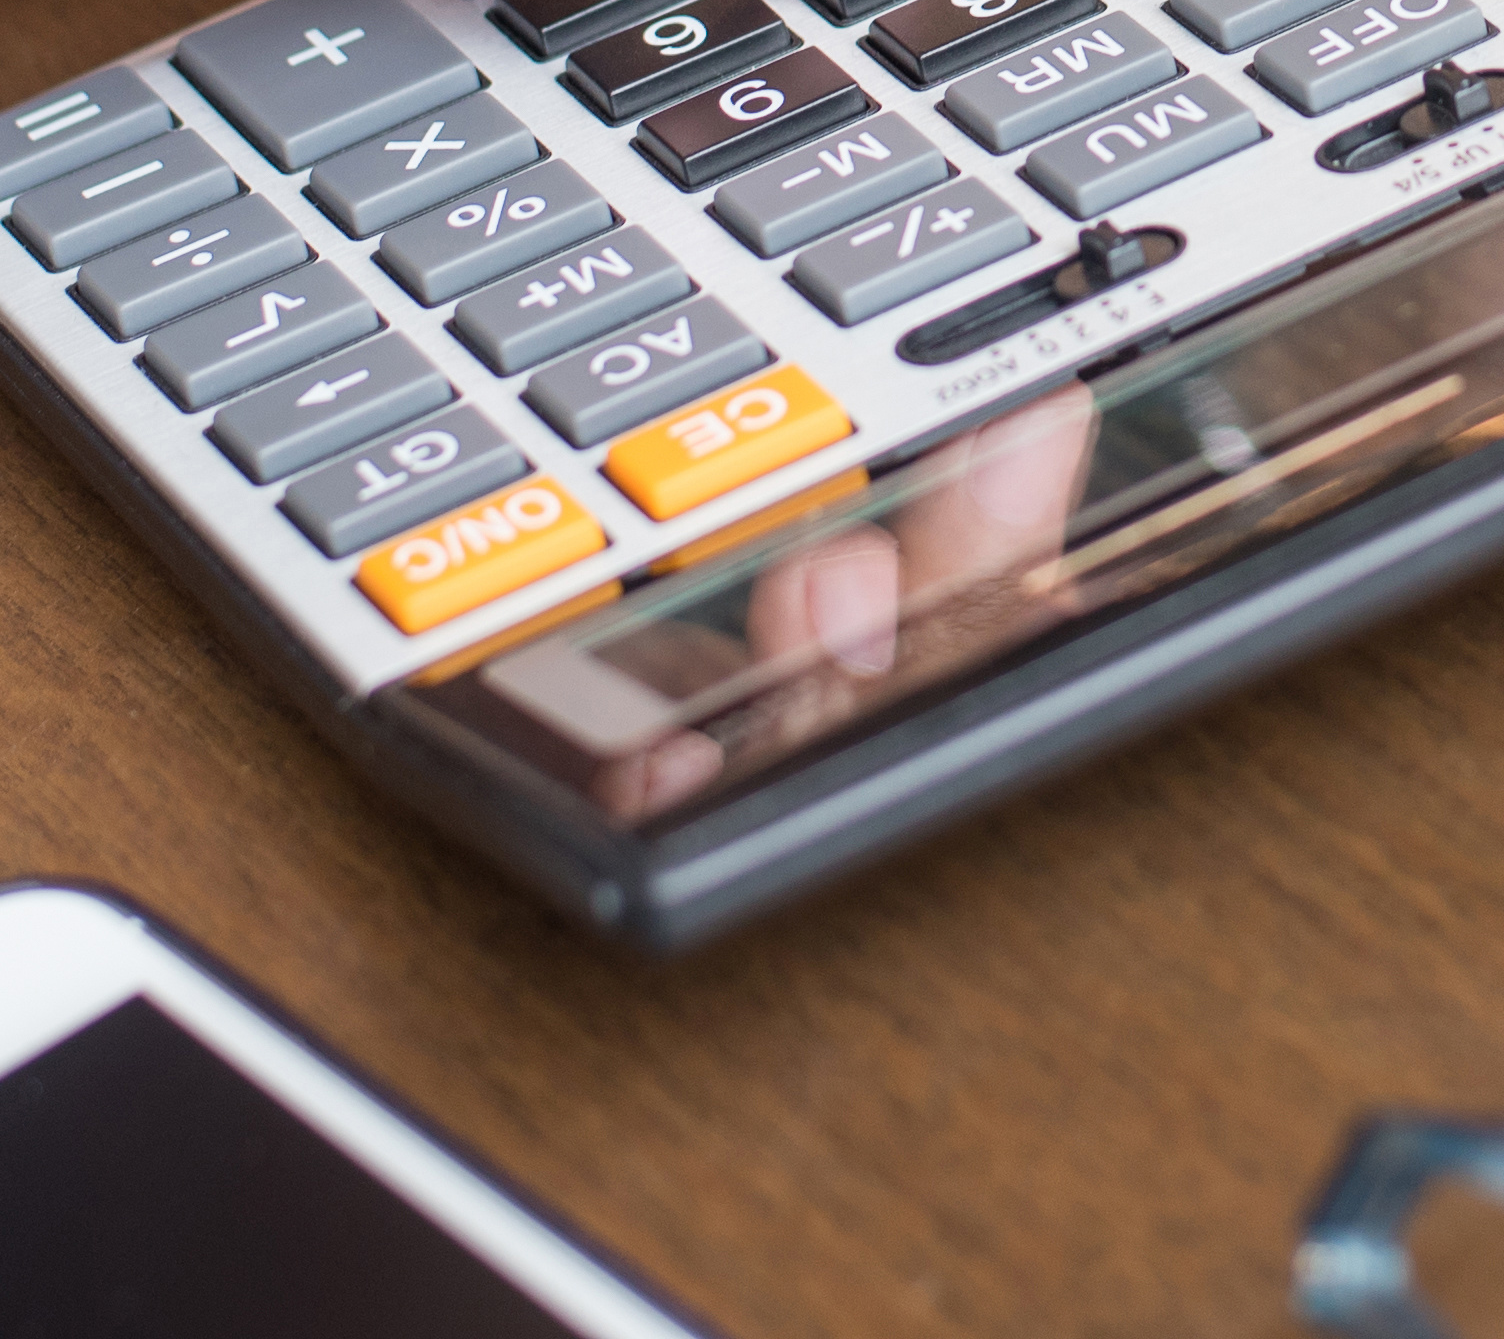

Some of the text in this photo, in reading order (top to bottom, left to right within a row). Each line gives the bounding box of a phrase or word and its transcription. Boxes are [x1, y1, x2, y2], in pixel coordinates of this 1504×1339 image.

[641, 14, 708, 56] 6
[997, 28, 1126, 96] MR
[716, 77, 787, 123] 9
[1083, 92, 1209, 165] MU
[446, 188, 548, 238] %
[519, 246, 634, 312] M+
[590, 317, 694, 385] AC
[672, 387, 789, 457] CE
[356, 431, 461, 502] GT
[391, 488, 564, 582] ON/C
